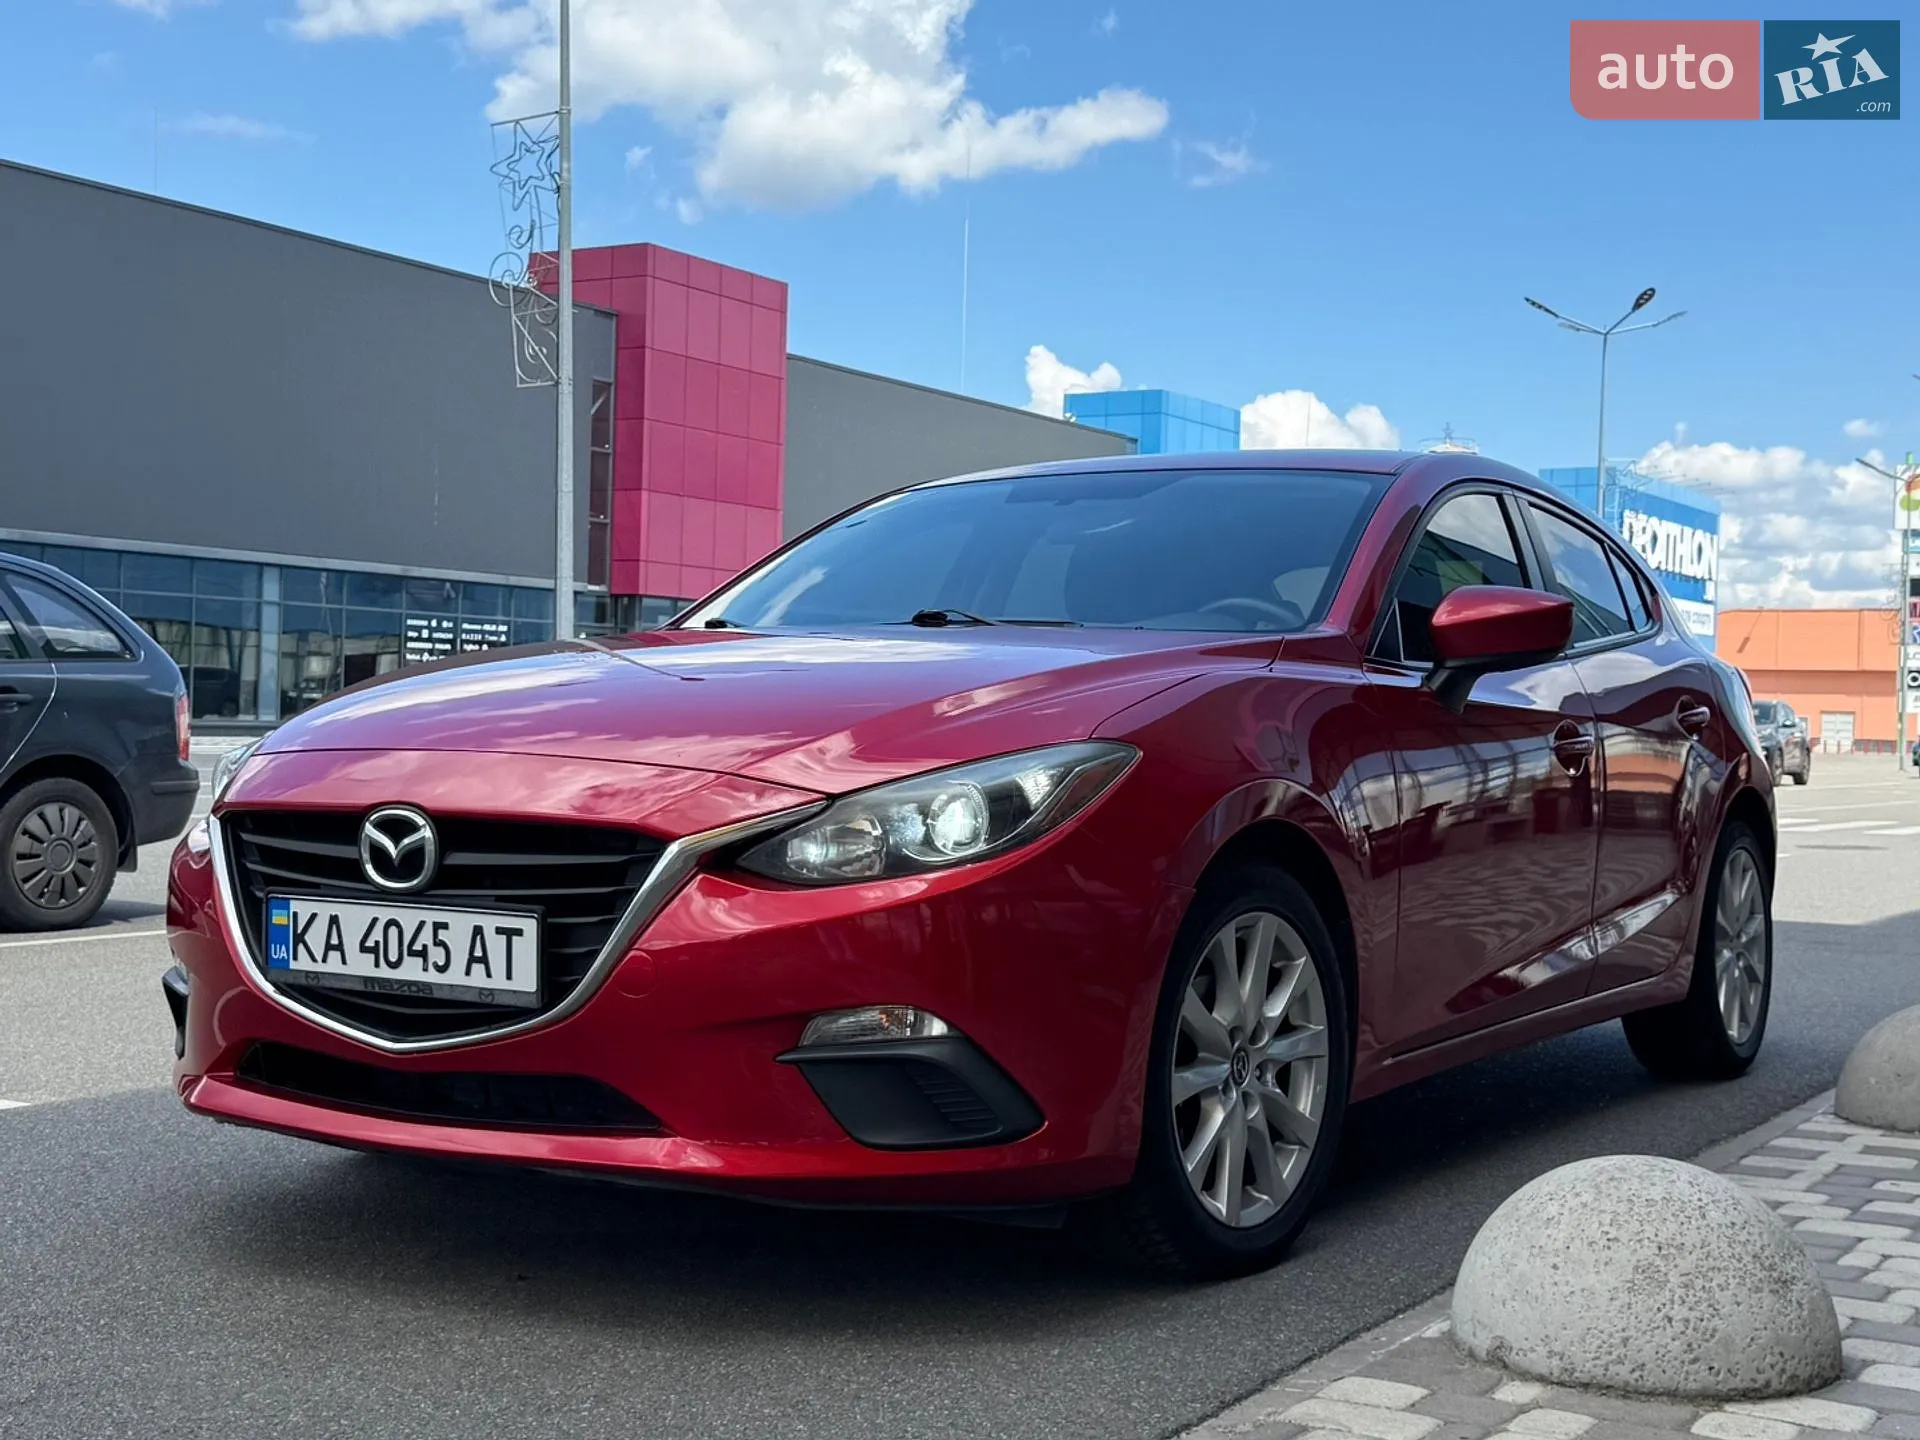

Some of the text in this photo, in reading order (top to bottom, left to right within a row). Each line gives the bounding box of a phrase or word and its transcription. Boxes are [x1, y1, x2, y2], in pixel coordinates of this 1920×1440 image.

[271, 942, 288, 960] UA
[291, 910, 524, 981] KA 4045 AT
